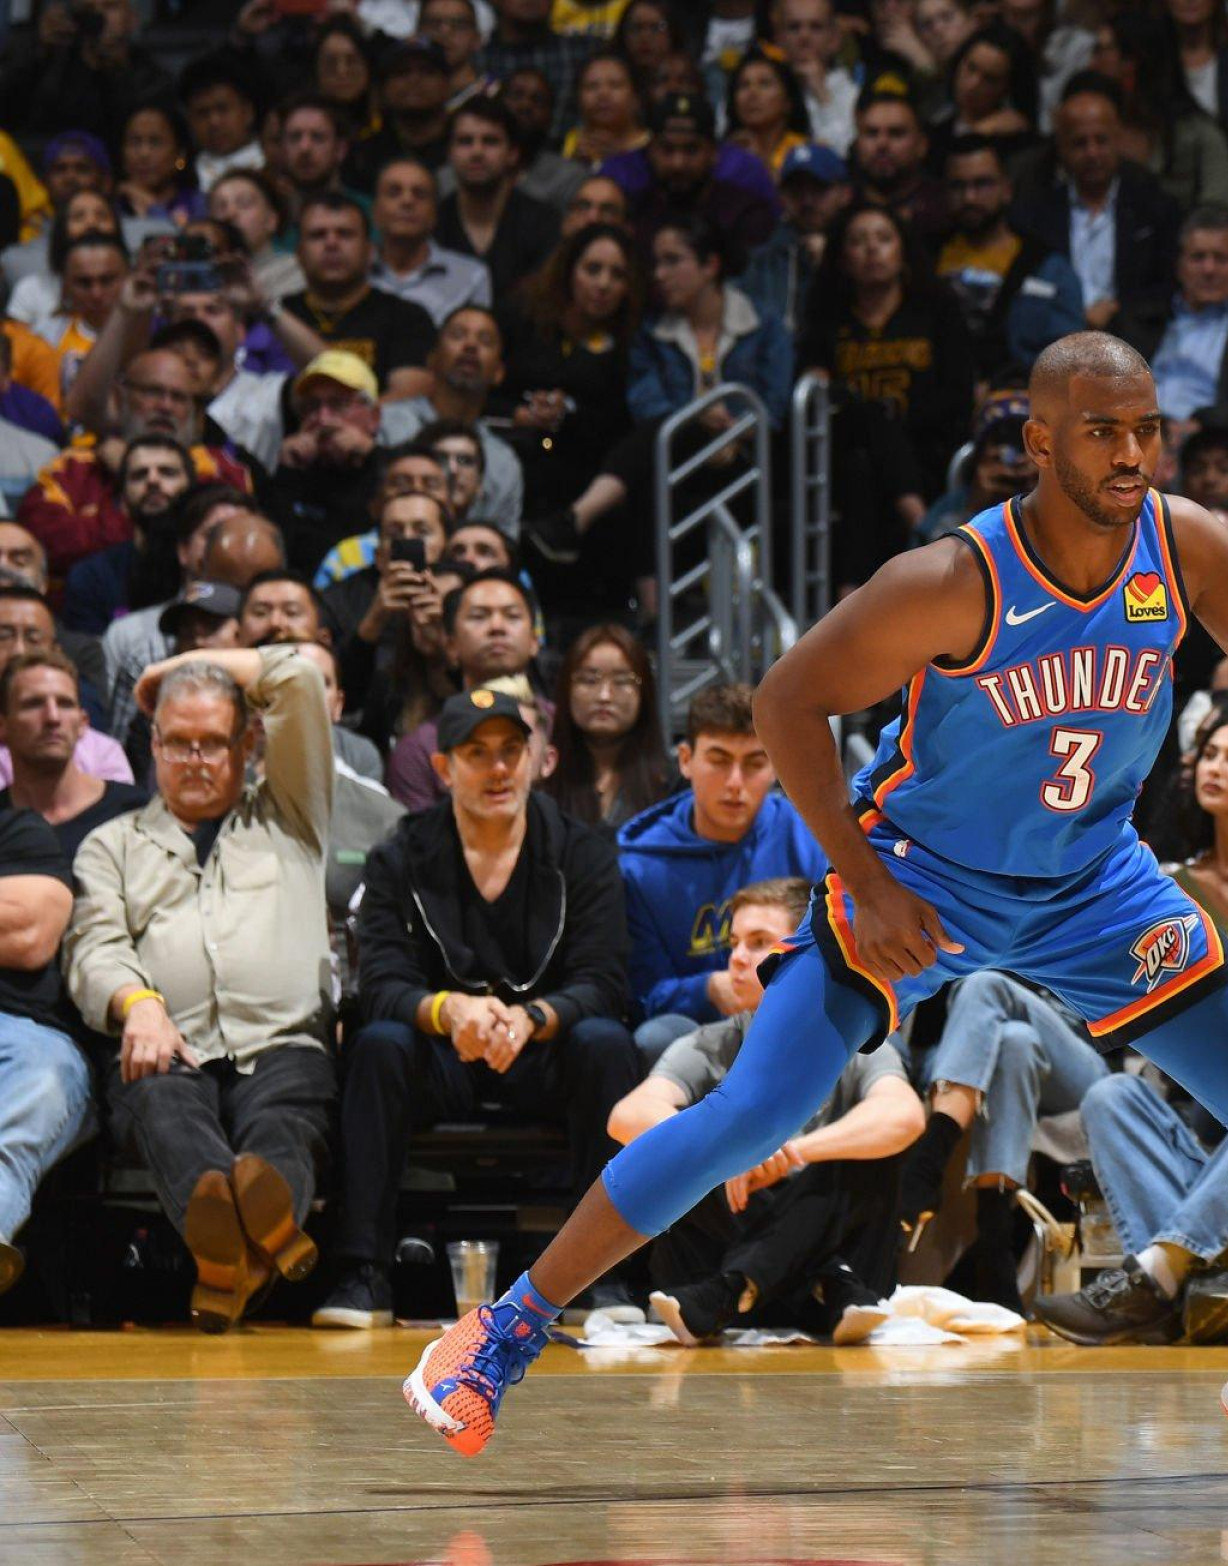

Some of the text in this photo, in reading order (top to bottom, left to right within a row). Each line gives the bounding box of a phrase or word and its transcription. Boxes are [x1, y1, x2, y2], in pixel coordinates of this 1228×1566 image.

[1128, 601, 1166, 618] Love's
[975, 643, 1170, 728] THUNDE
[1040, 726, 1104, 814] 3
